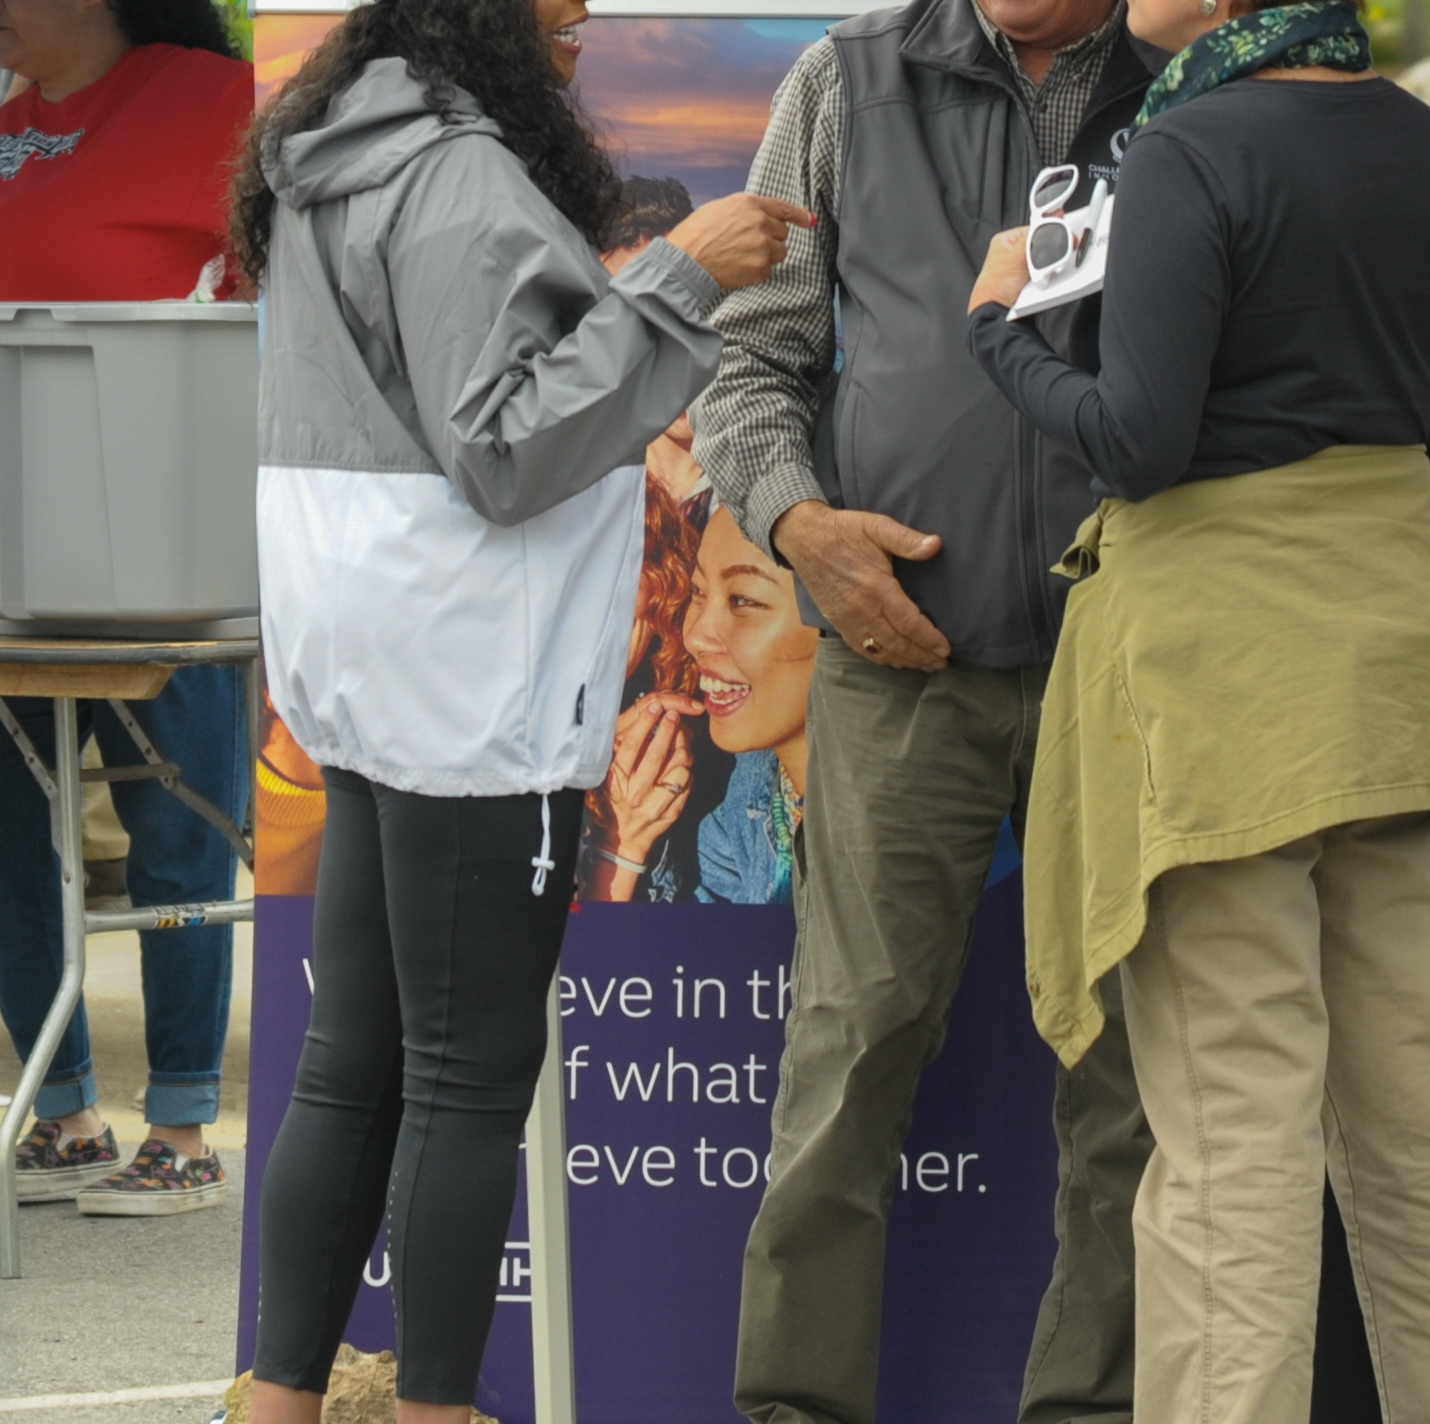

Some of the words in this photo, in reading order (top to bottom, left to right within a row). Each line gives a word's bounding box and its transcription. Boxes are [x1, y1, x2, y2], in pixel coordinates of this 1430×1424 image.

[559, 975, 653, 1018] eve
[672, 965, 726, 1018] in
[746, 964, 792, 1020] th
[564, 1045, 590, 1100] f
[606, 1046, 767, 1103] what
[566, 1143, 676, 1187] eve
